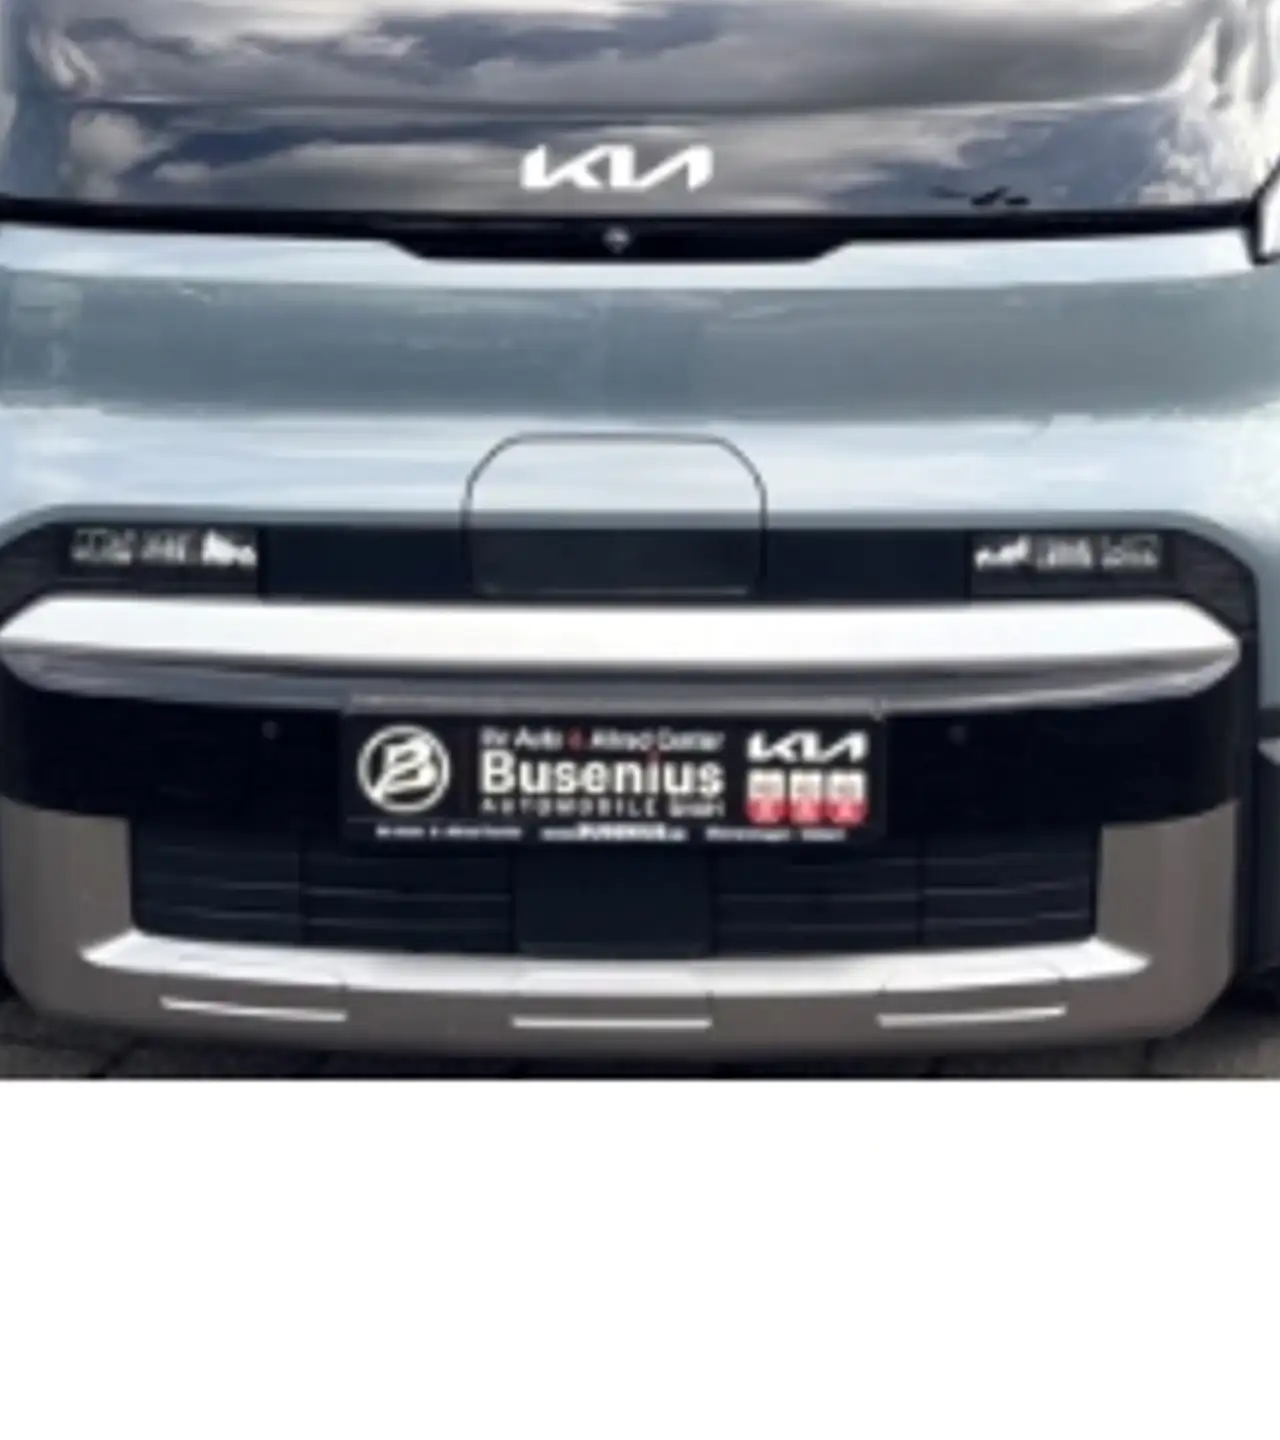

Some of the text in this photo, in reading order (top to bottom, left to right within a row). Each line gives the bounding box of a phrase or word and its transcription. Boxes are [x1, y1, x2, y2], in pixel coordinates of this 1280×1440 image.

[520, 142, 714, 192] KIA
[480, 745, 725, 797] Busenius
[747, 729, 869, 763] KIA
